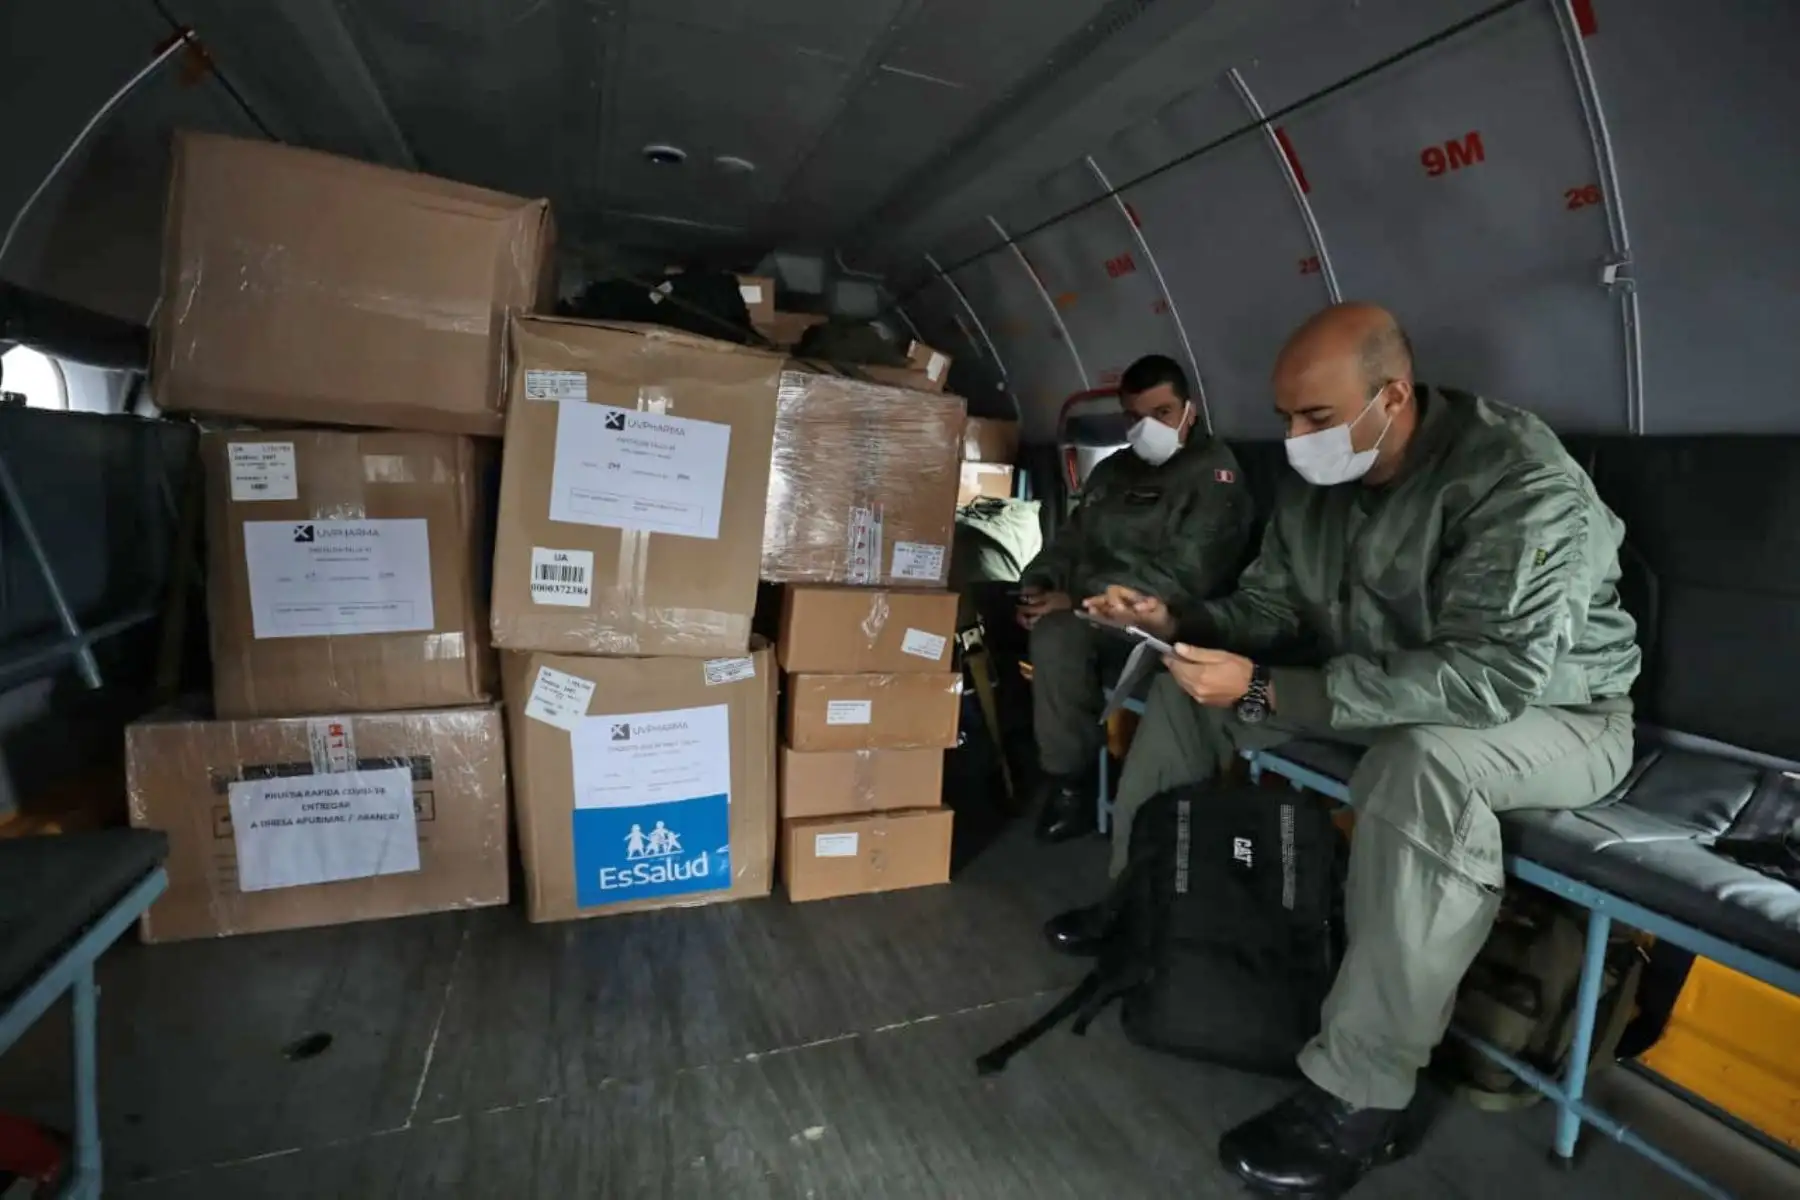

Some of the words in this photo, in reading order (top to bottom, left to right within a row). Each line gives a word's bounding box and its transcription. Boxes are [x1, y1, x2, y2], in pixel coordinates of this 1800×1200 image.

[1421, 130, 1485, 177] 9M
[1564, 184, 1602, 210] 26
[317, 527, 380, 538] UVPHARMA
[600, 851, 709, 890] EsSalud
